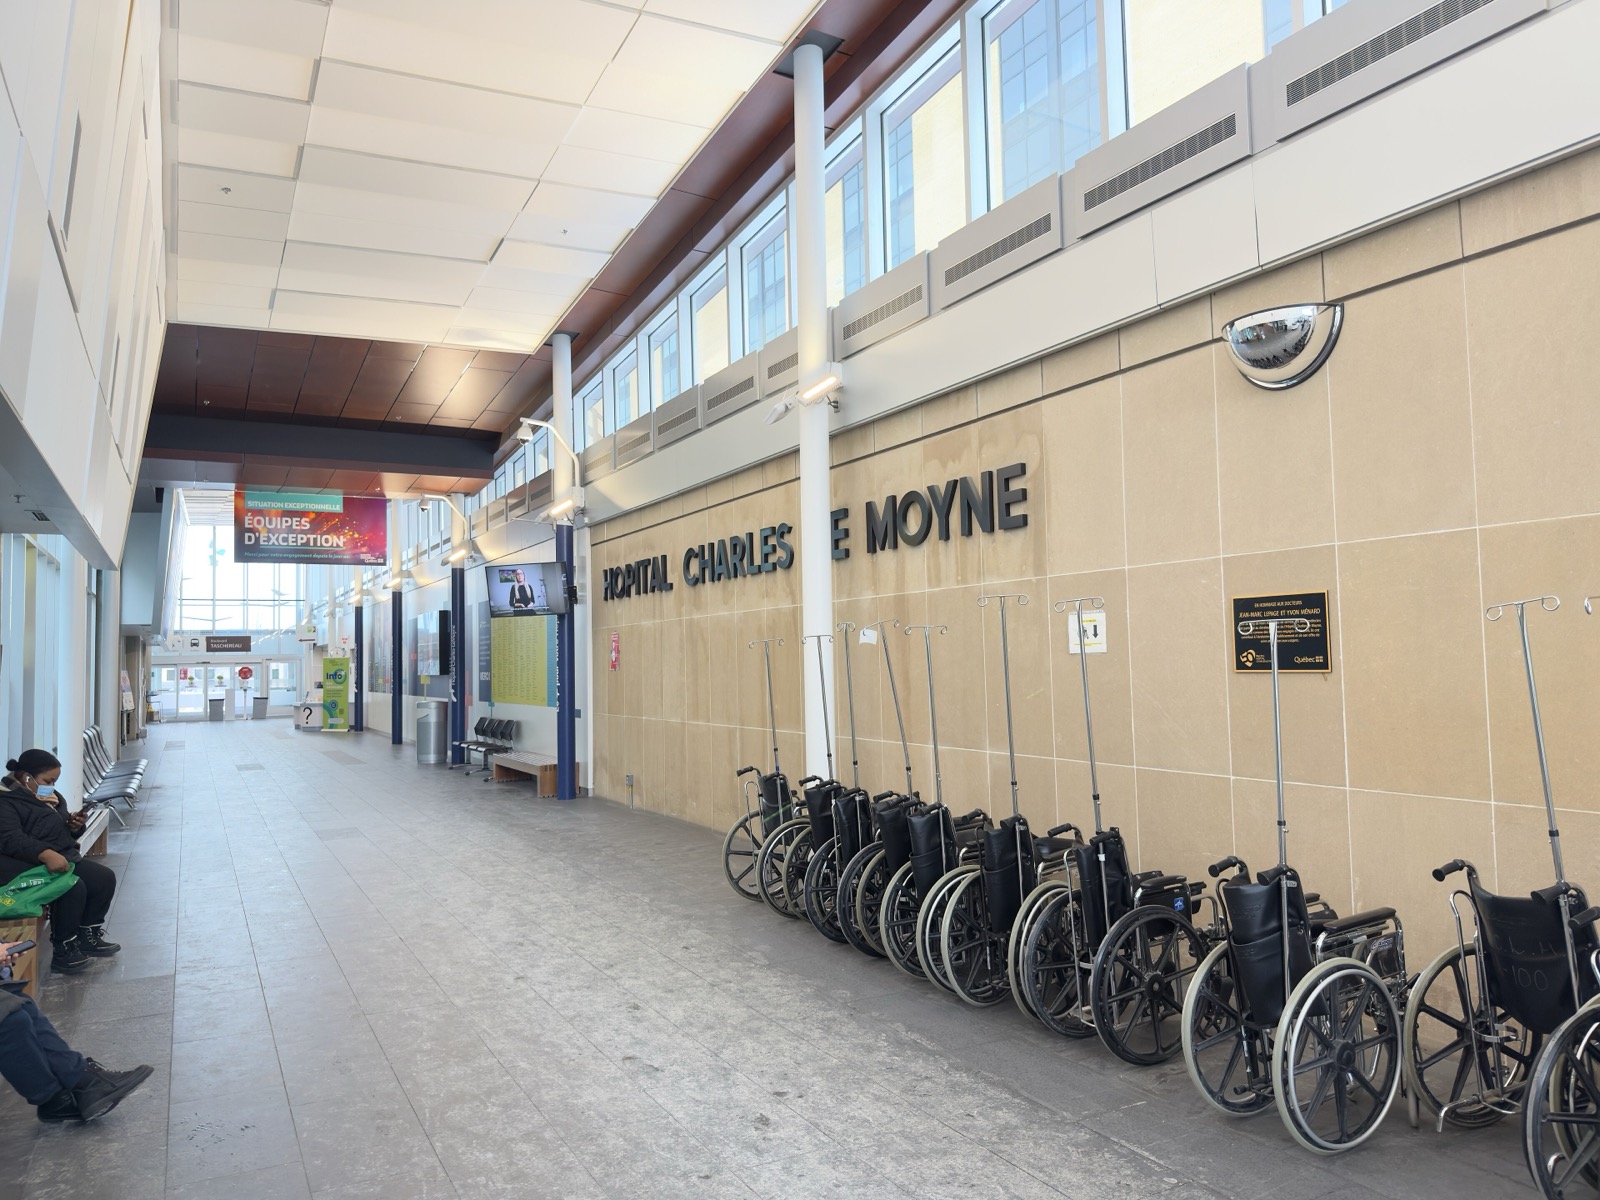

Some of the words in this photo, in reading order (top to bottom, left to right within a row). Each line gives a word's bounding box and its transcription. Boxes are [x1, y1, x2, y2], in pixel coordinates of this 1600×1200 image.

[285, 502, 340, 510] EXCEPTIONNELLE
[245, 513, 310, 530] ÉQUIPES
[603, 554, 673, 602] HOPITAL
[682, 522, 795, 587] CHARLES
[830, 507, 850, 561] E
[865, 462, 1028, 554] MOYNE
[244, 532, 344, 547] D'EXCEPTION
[1287, 608, 1300, 616] YVON
[1294, 656, 1315, 664] Québec
[326, 672, 343, 680] Info
